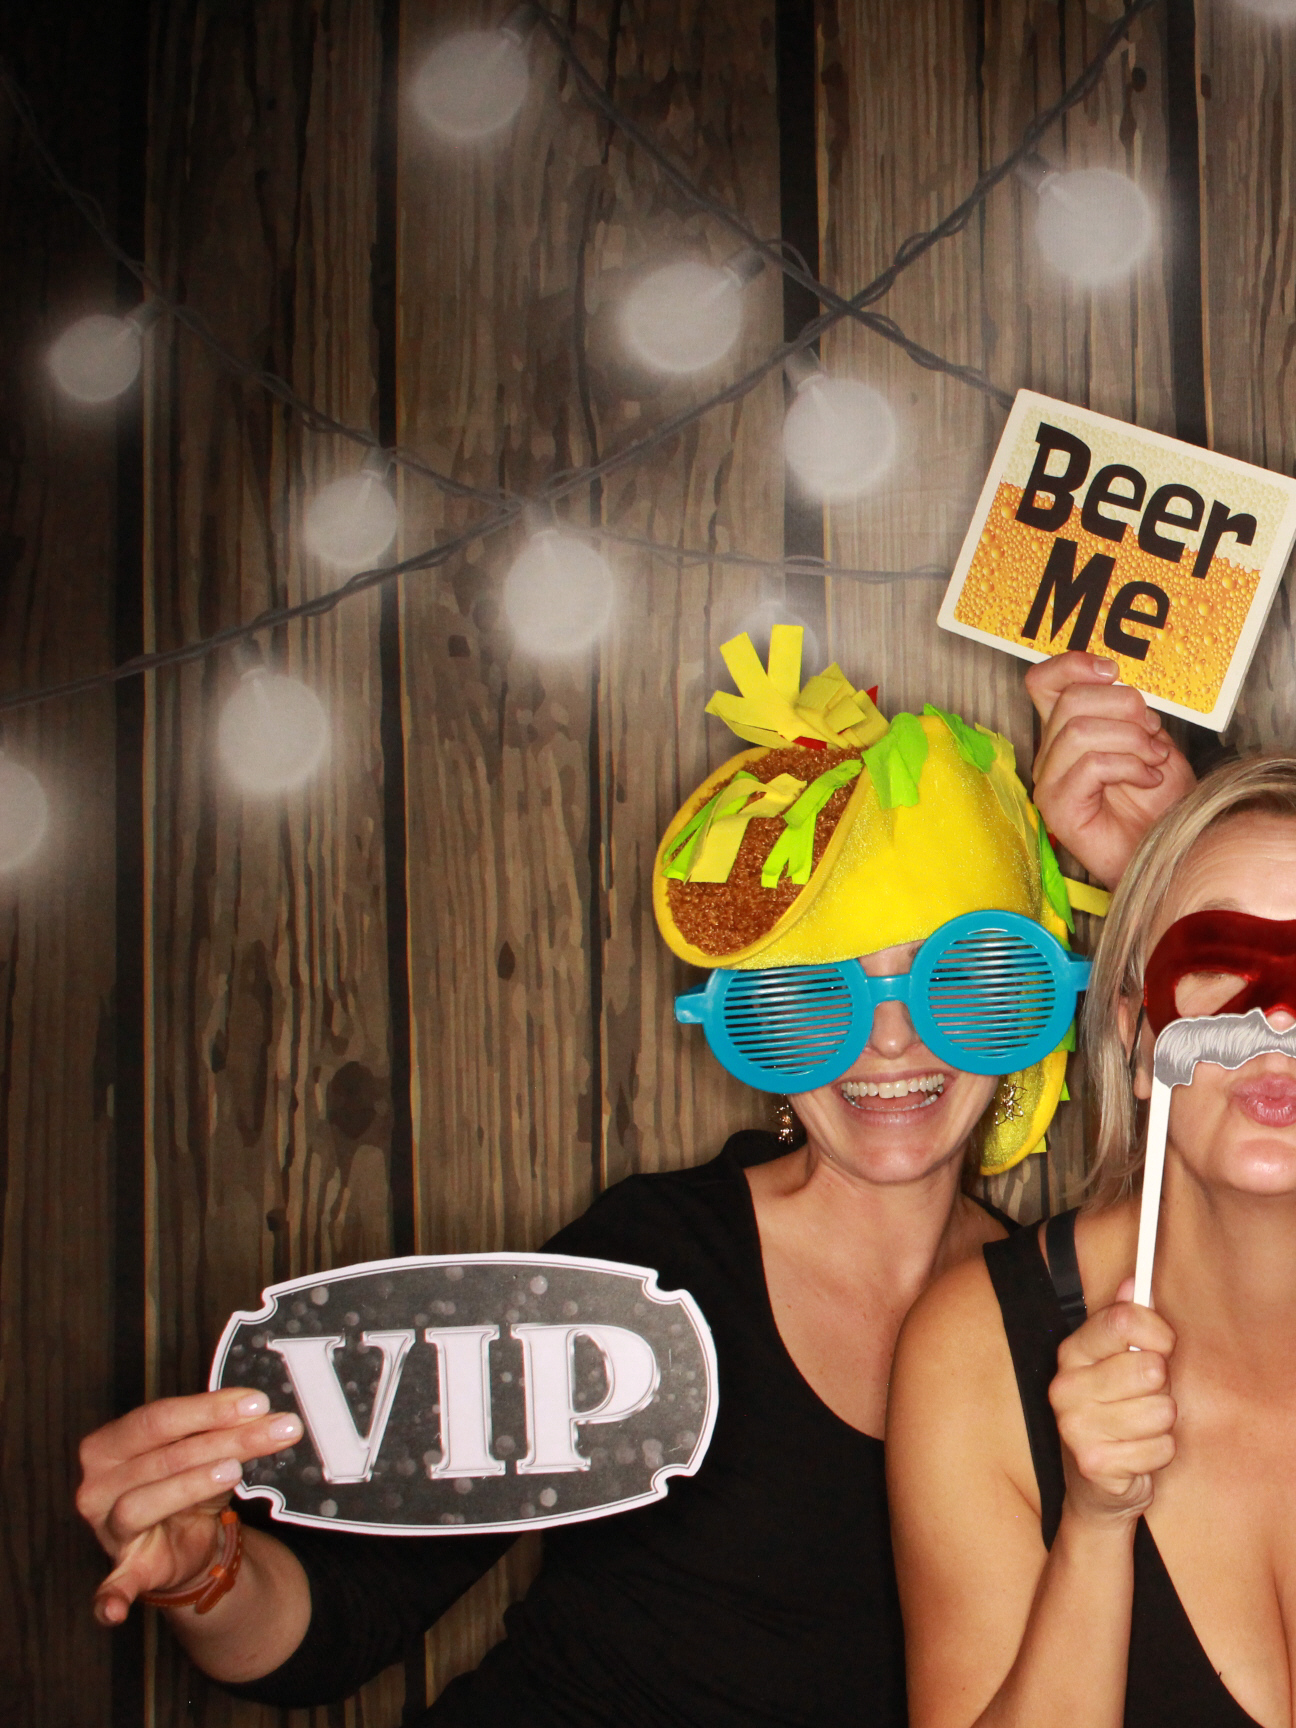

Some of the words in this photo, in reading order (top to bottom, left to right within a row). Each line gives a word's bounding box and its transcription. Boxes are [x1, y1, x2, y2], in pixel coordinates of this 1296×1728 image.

[1015, 421, 1257, 580] Beer
[1021, 536, 1170, 661] Me
[266, 1323, 661, 1485] VIP
